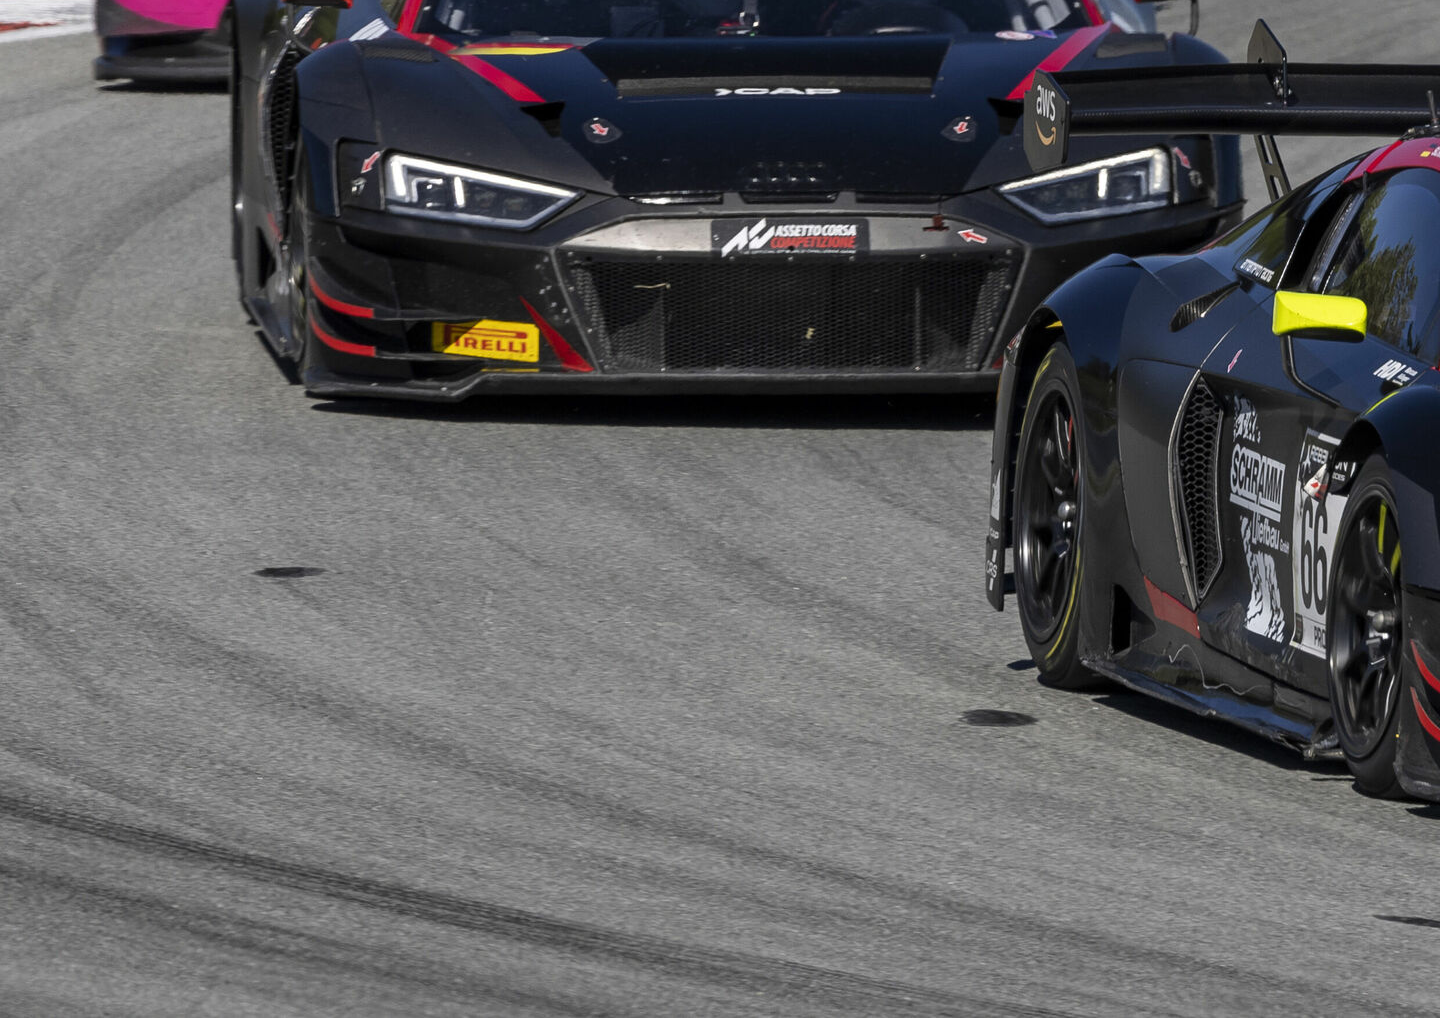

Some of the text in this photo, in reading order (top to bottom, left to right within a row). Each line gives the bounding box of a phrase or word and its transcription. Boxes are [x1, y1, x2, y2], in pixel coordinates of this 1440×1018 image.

[1036, 84, 1057, 122] aws
[769, 235, 857, 250] COMPETIZIONE
[775, 224, 858, 237] ASSETTO CORSA
[442, 322, 529, 355] PIRELLI
[1231, 445, 1284, 513] SCHRAMM
[1301, 495, 1330, 617] 66
